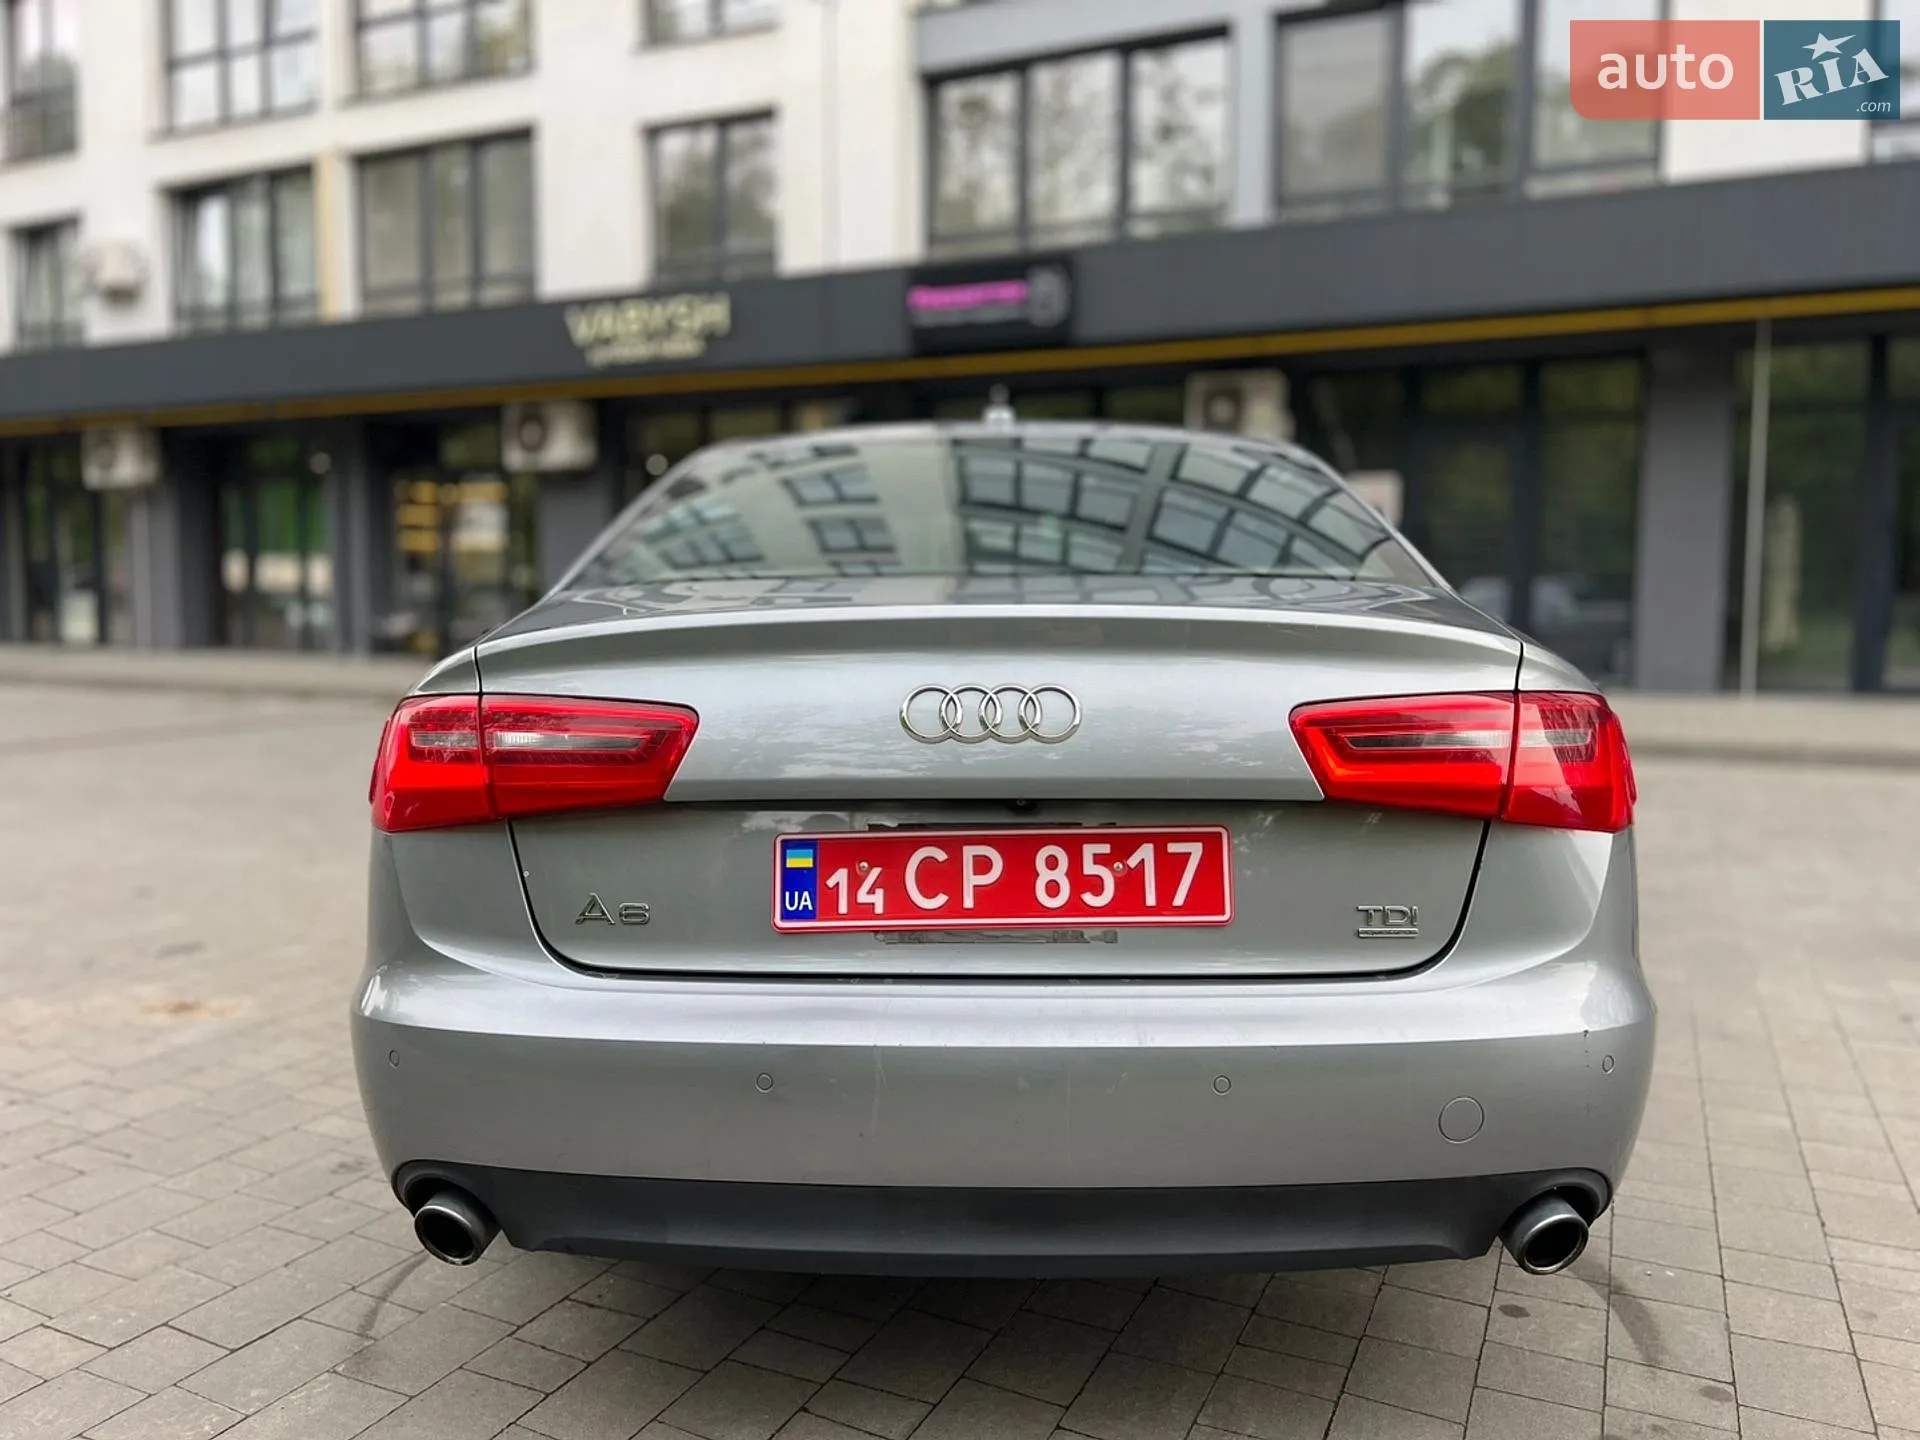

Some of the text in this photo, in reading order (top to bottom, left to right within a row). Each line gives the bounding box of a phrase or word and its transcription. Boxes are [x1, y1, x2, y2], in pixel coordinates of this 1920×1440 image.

[825, 842, 1203, 915] 14 CP 8517
[575, 892, 650, 925] A6
[785, 890, 814, 912] UA
[1356, 905, 1419, 926] TDI
